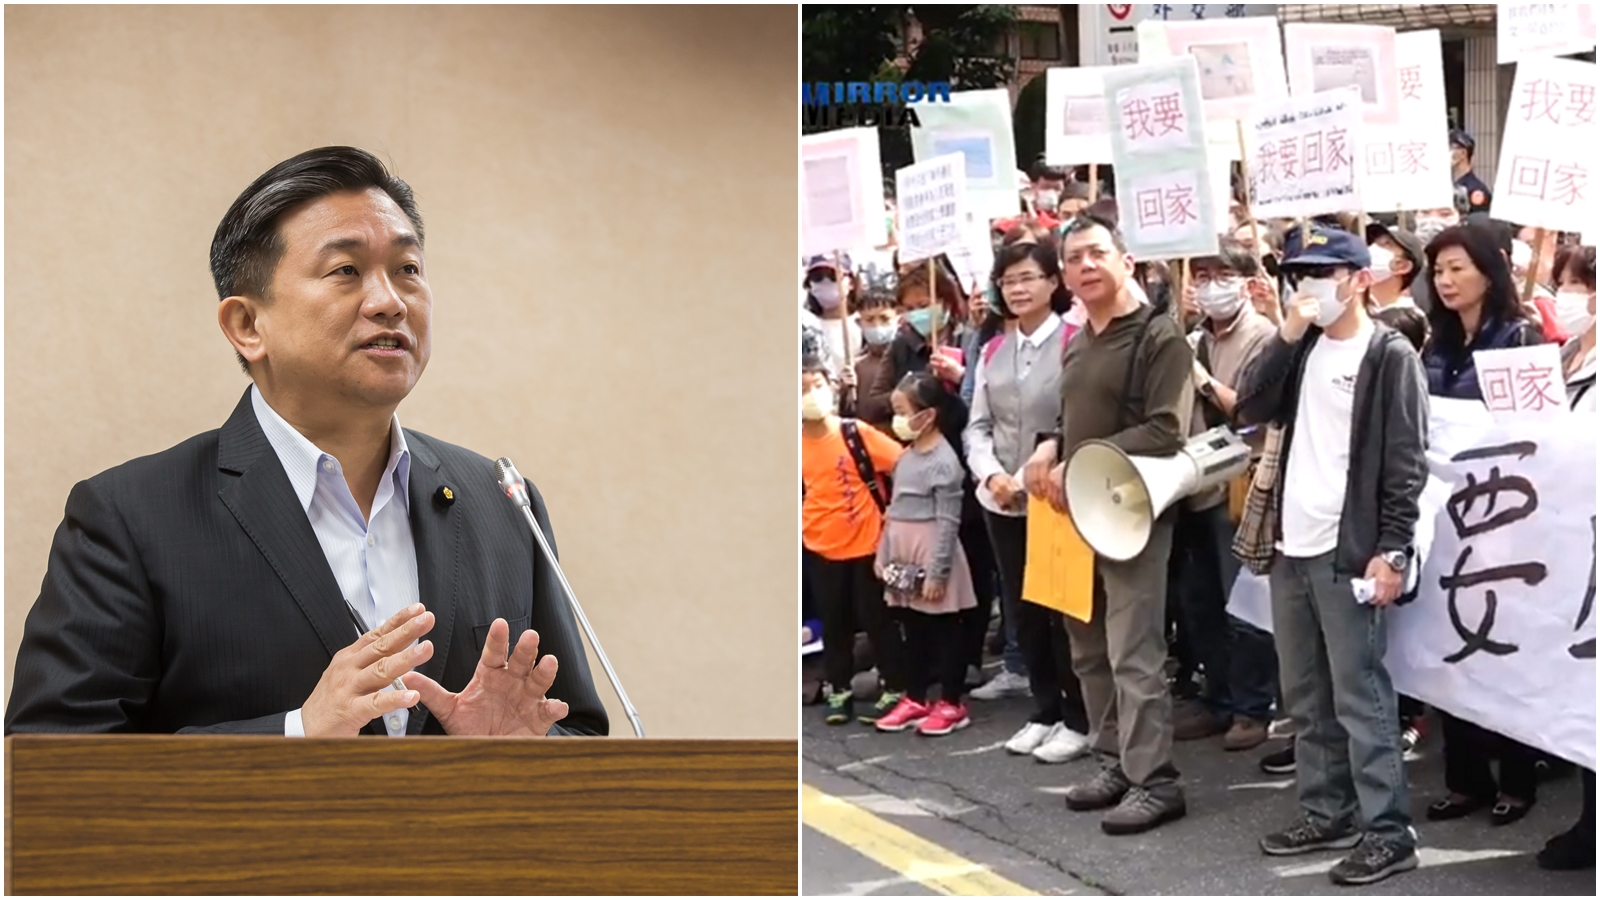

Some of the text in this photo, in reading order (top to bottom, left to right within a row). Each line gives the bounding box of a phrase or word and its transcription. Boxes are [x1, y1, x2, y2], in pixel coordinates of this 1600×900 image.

[1398, 64, 1423, 100] 要
[1520, 78, 1596, 126] 我要
[1123, 92, 1184, 141] 我要
[1256, 125, 1349, 185] 我要回家
[1365, 139, 1430, 176] 回家
[1508, 154, 1588, 206] 回家
[1136, 183, 1198, 230] 回家
[1481, 362, 1561, 413] 回家
[1439, 440, 1596, 664] 要
